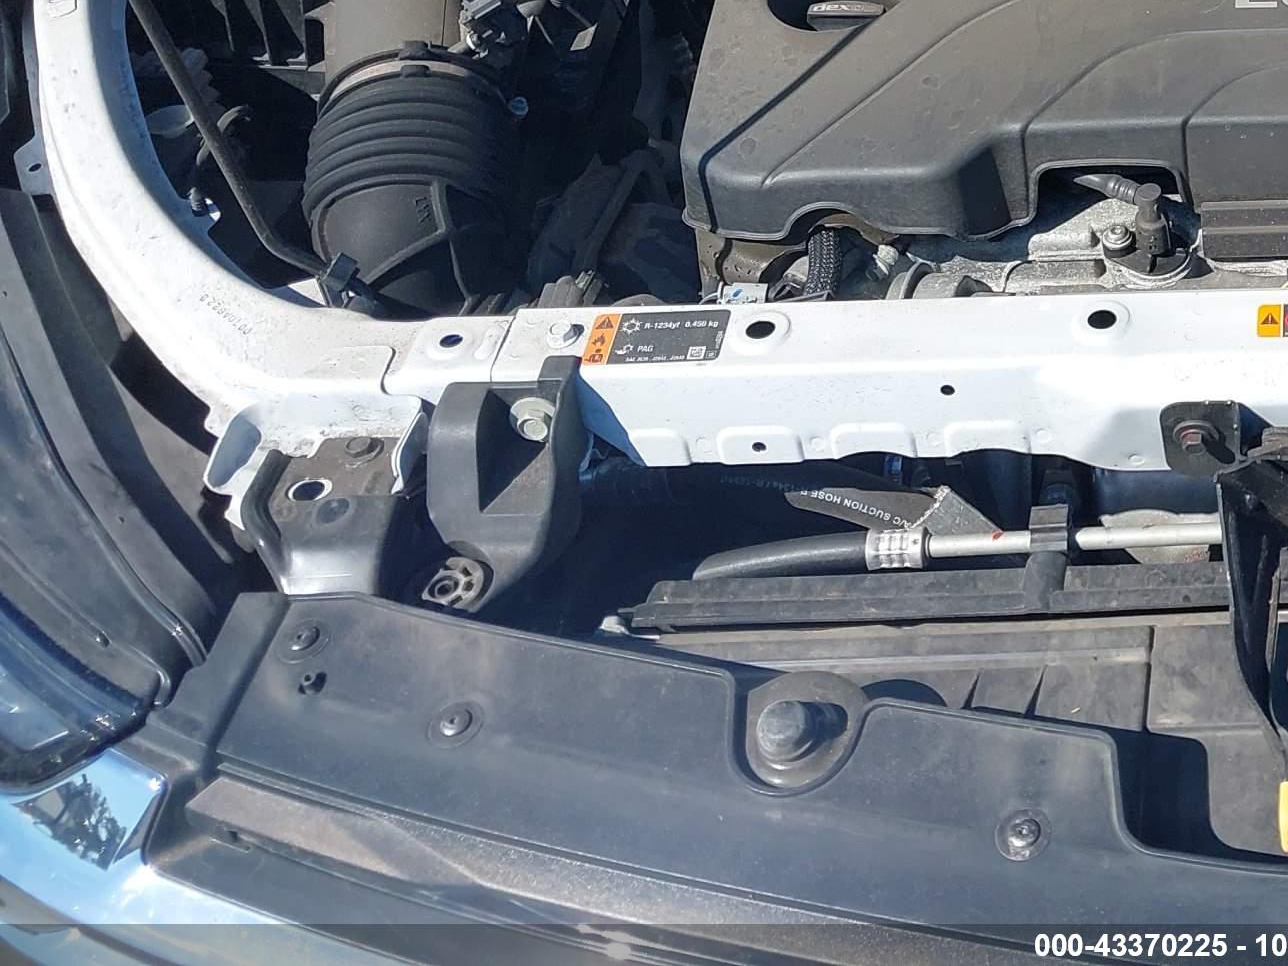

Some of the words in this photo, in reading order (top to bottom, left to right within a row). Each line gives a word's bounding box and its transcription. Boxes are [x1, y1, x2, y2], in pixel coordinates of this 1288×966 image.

[637, 345, 654, 353] PAG
[810, 489, 842, 505] HOSE
[842, 497, 891, 523] SUCTION
[892, 516, 913, 530] A/C
